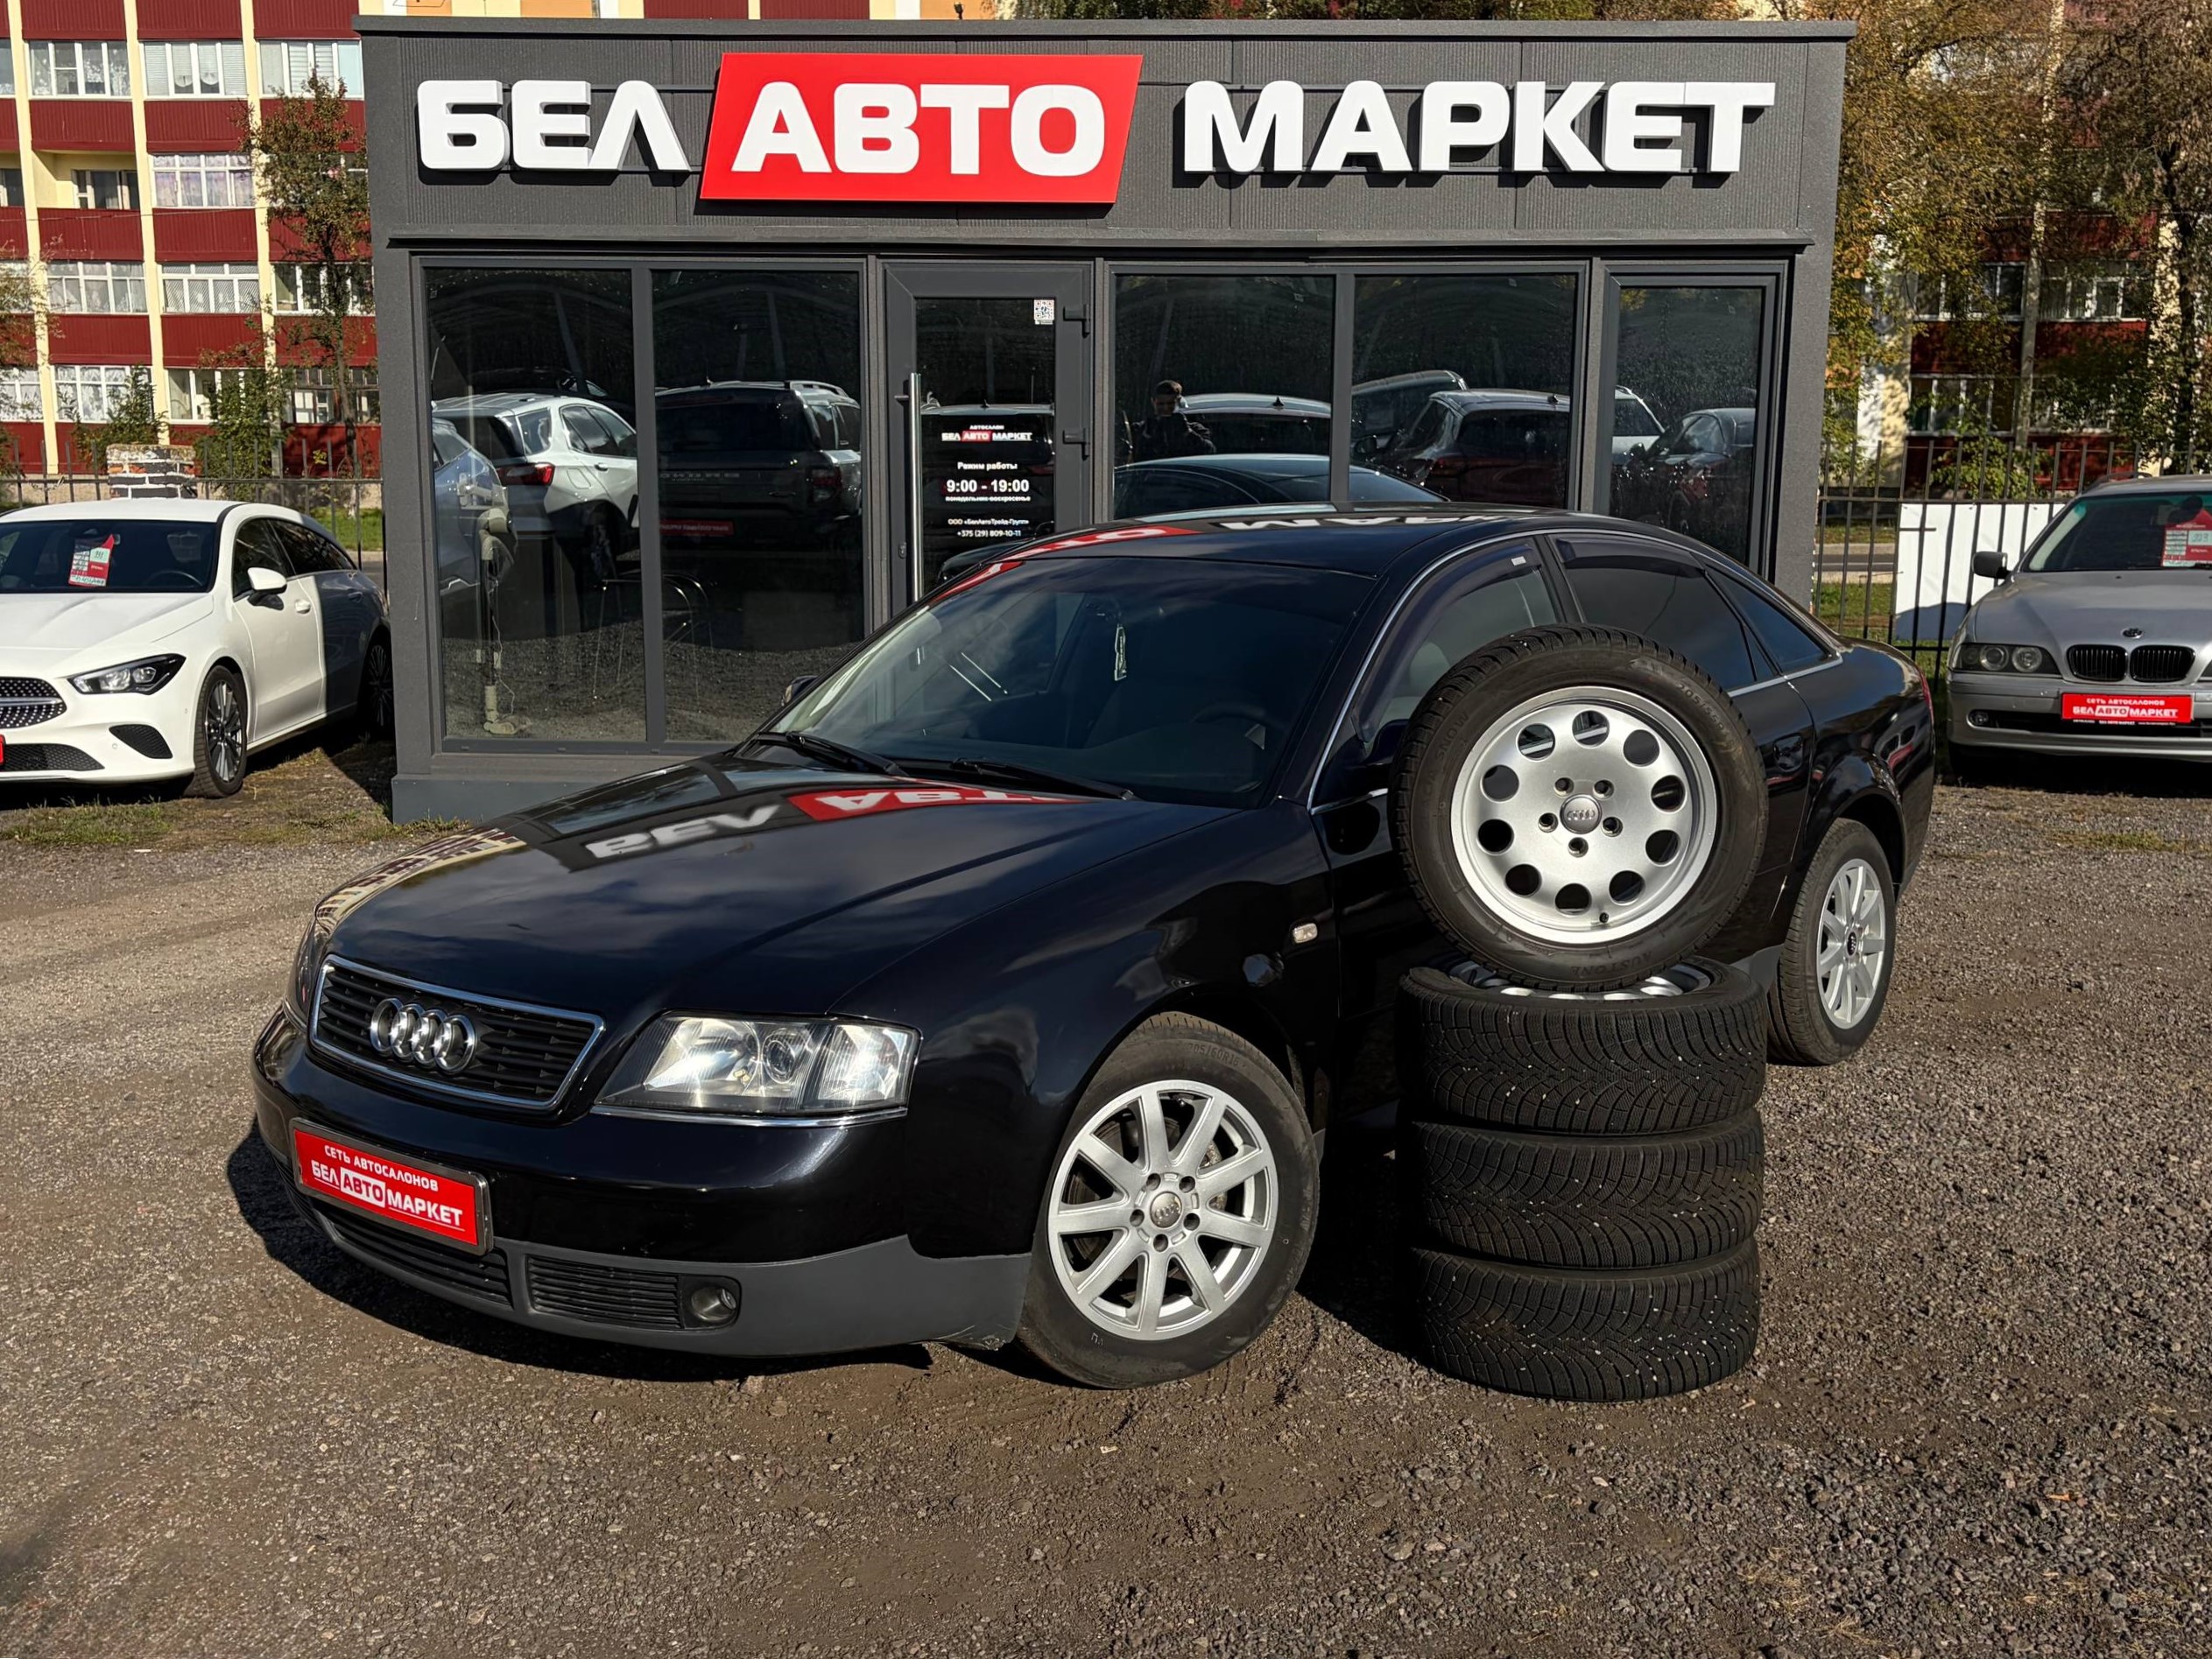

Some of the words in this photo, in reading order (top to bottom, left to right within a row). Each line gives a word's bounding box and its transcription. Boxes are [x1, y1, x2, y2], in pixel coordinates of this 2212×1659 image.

[418, 80, 692, 172] БЕЛ
[730, 81, 1106, 178] АВТО
[1183, 80, 1777, 173] МАРКЕТ
[962, 432, 990, 440] АВТО
[991, 432, 1032, 440] МАРКЕТ
[957, 461, 985, 470] Режим
[986, 461, 1018, 471] работы
[946, 479, 977, 493] 9:00
[990, 479, 1030, 493] 19:00
[2073, 706, 2095, 715] БЕЛ
[2097, 706, 2128, 715] АВТО
[2129, 707, 2179, 717] МАРКЕТ
[324, 1144, 351, 1163] СЕТЬ
[353, 1155, 439, 1192] АВТОСАЛОНОВ
[311, 1159, 340, 1186] БЕЛ
[342, 1172, 384, 1202] АВТО
[386, 1188, 463, 1227] МАРКЕТ
